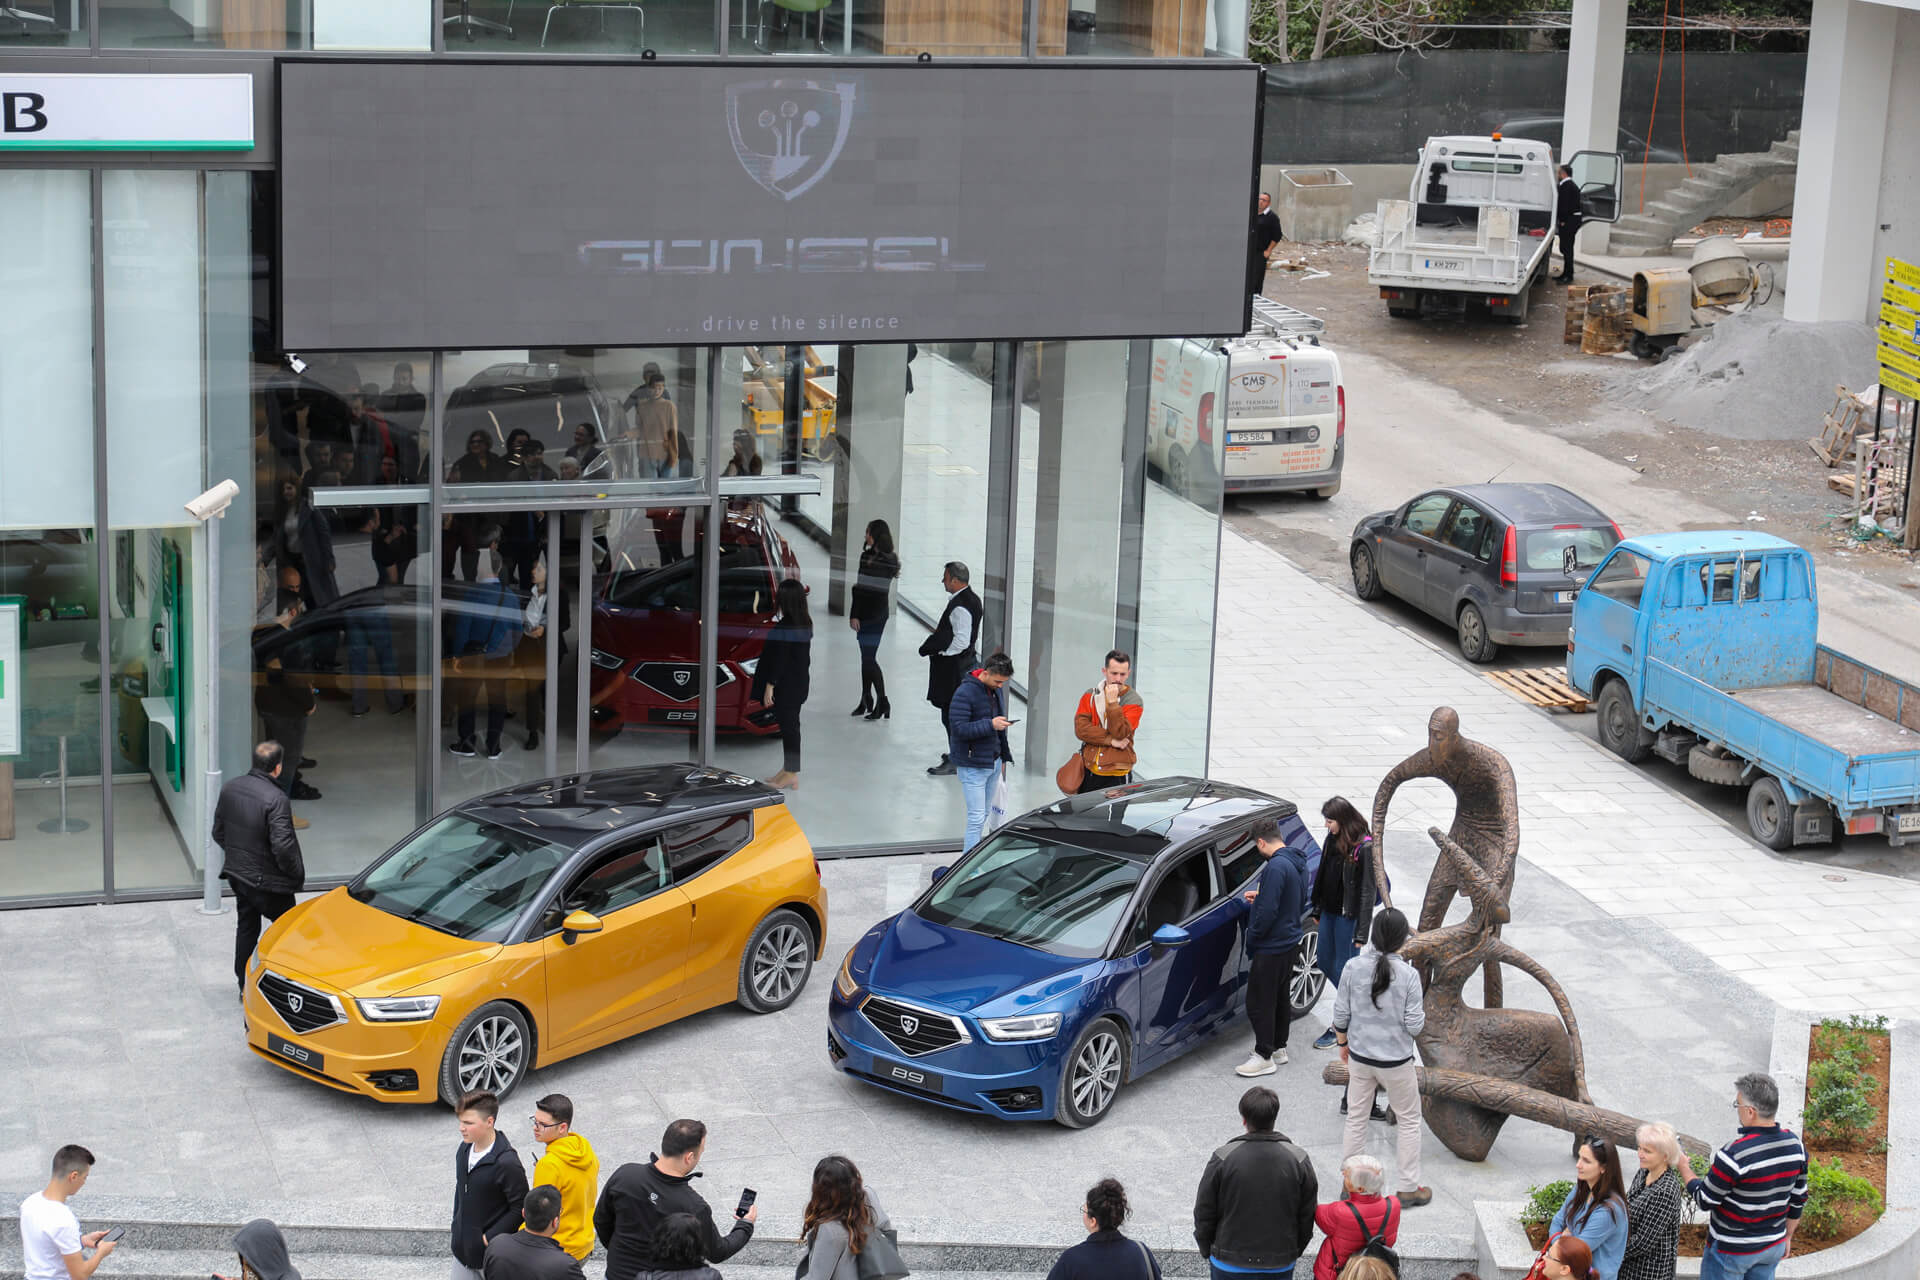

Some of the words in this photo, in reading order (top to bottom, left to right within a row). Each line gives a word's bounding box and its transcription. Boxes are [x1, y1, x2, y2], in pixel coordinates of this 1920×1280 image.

[3, 92, 48, 133] B
[703, 315, 759, 332] drive
[772, 315, 806, 331] the
[818, 314, 900, 330] silence
[1242, 375, 1266, 386] CMS
[1239, 432, 1249, 441] PS
[1250, 432, 1265, 441] 584
